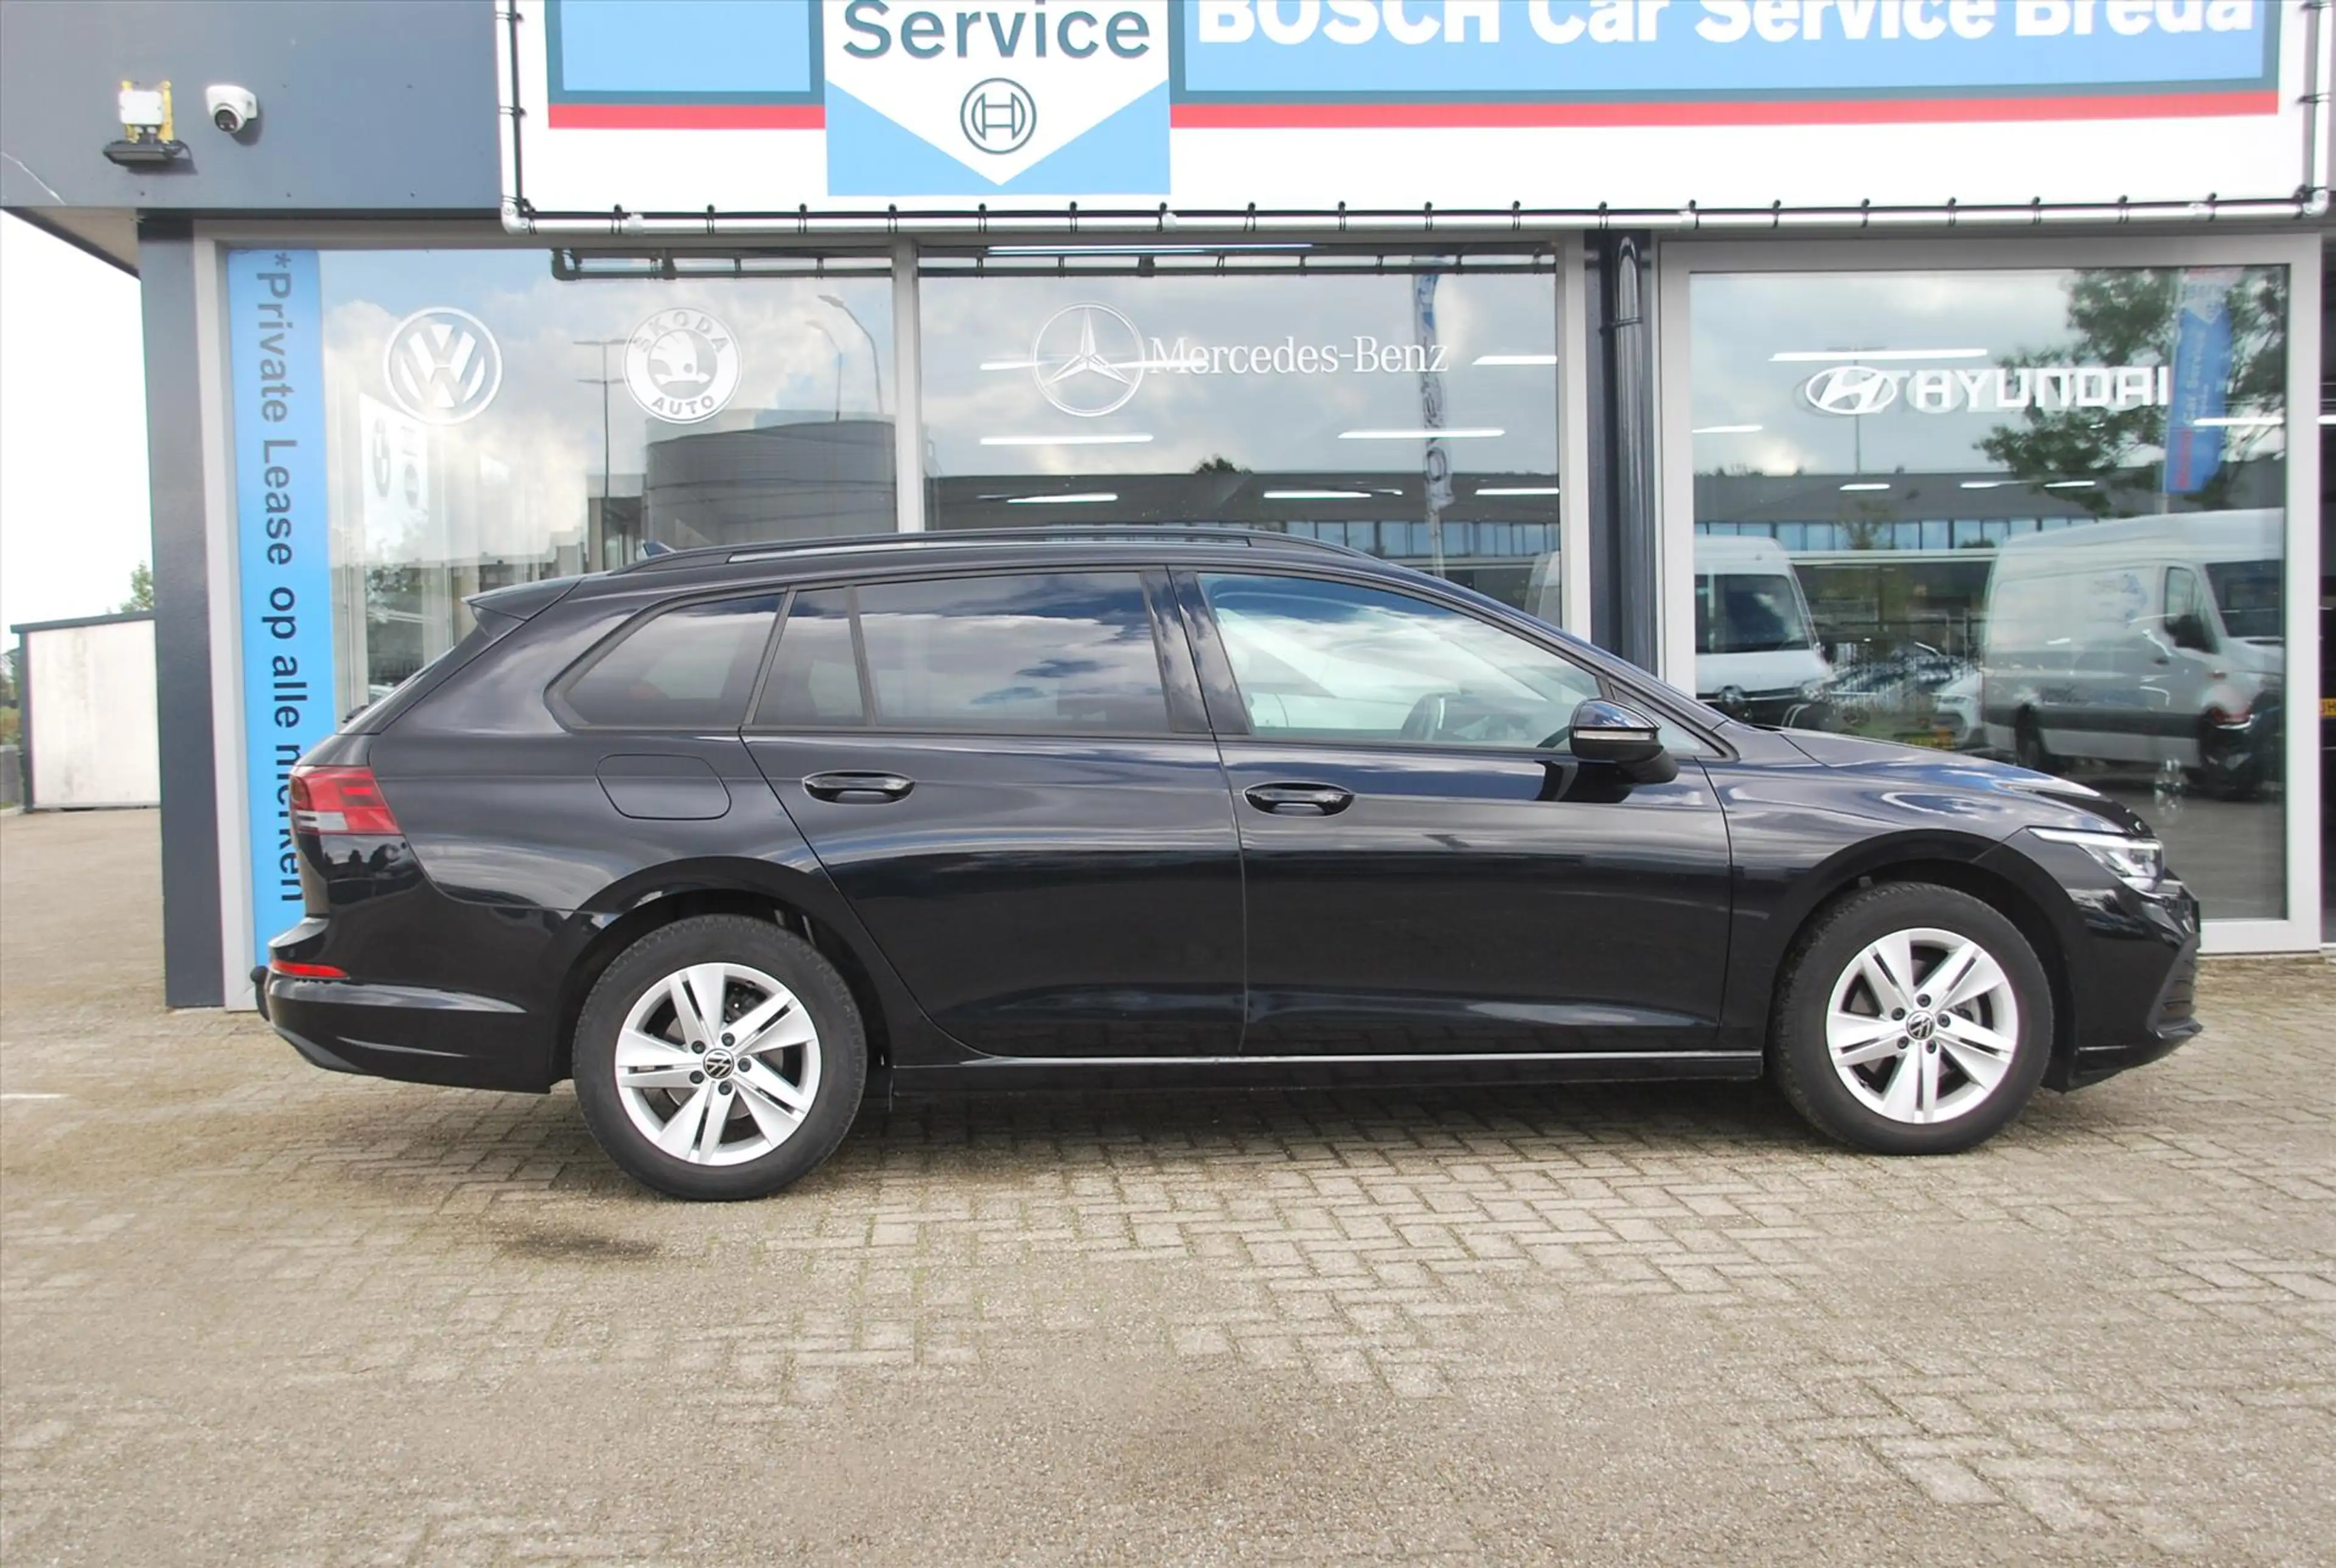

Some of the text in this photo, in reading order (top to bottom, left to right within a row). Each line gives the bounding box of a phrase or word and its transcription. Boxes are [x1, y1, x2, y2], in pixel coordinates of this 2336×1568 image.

[843, 0, 1150, 58] Service
[1199, 0, 1500, 44] BOSCH
[1528, 0, 1670, 44] Car
[1694, 0, 1995, 43] Service
[1149, 335, 1450, 374] Mercedes-Benz
[652, 395, 714, 415] AUTO
[1916, 366, 2171, 409] HYUNDAI
[263, 440, 297, 565] Lease
[262, 586, 296, 639] op
[272, 655, 308, 729] alle
